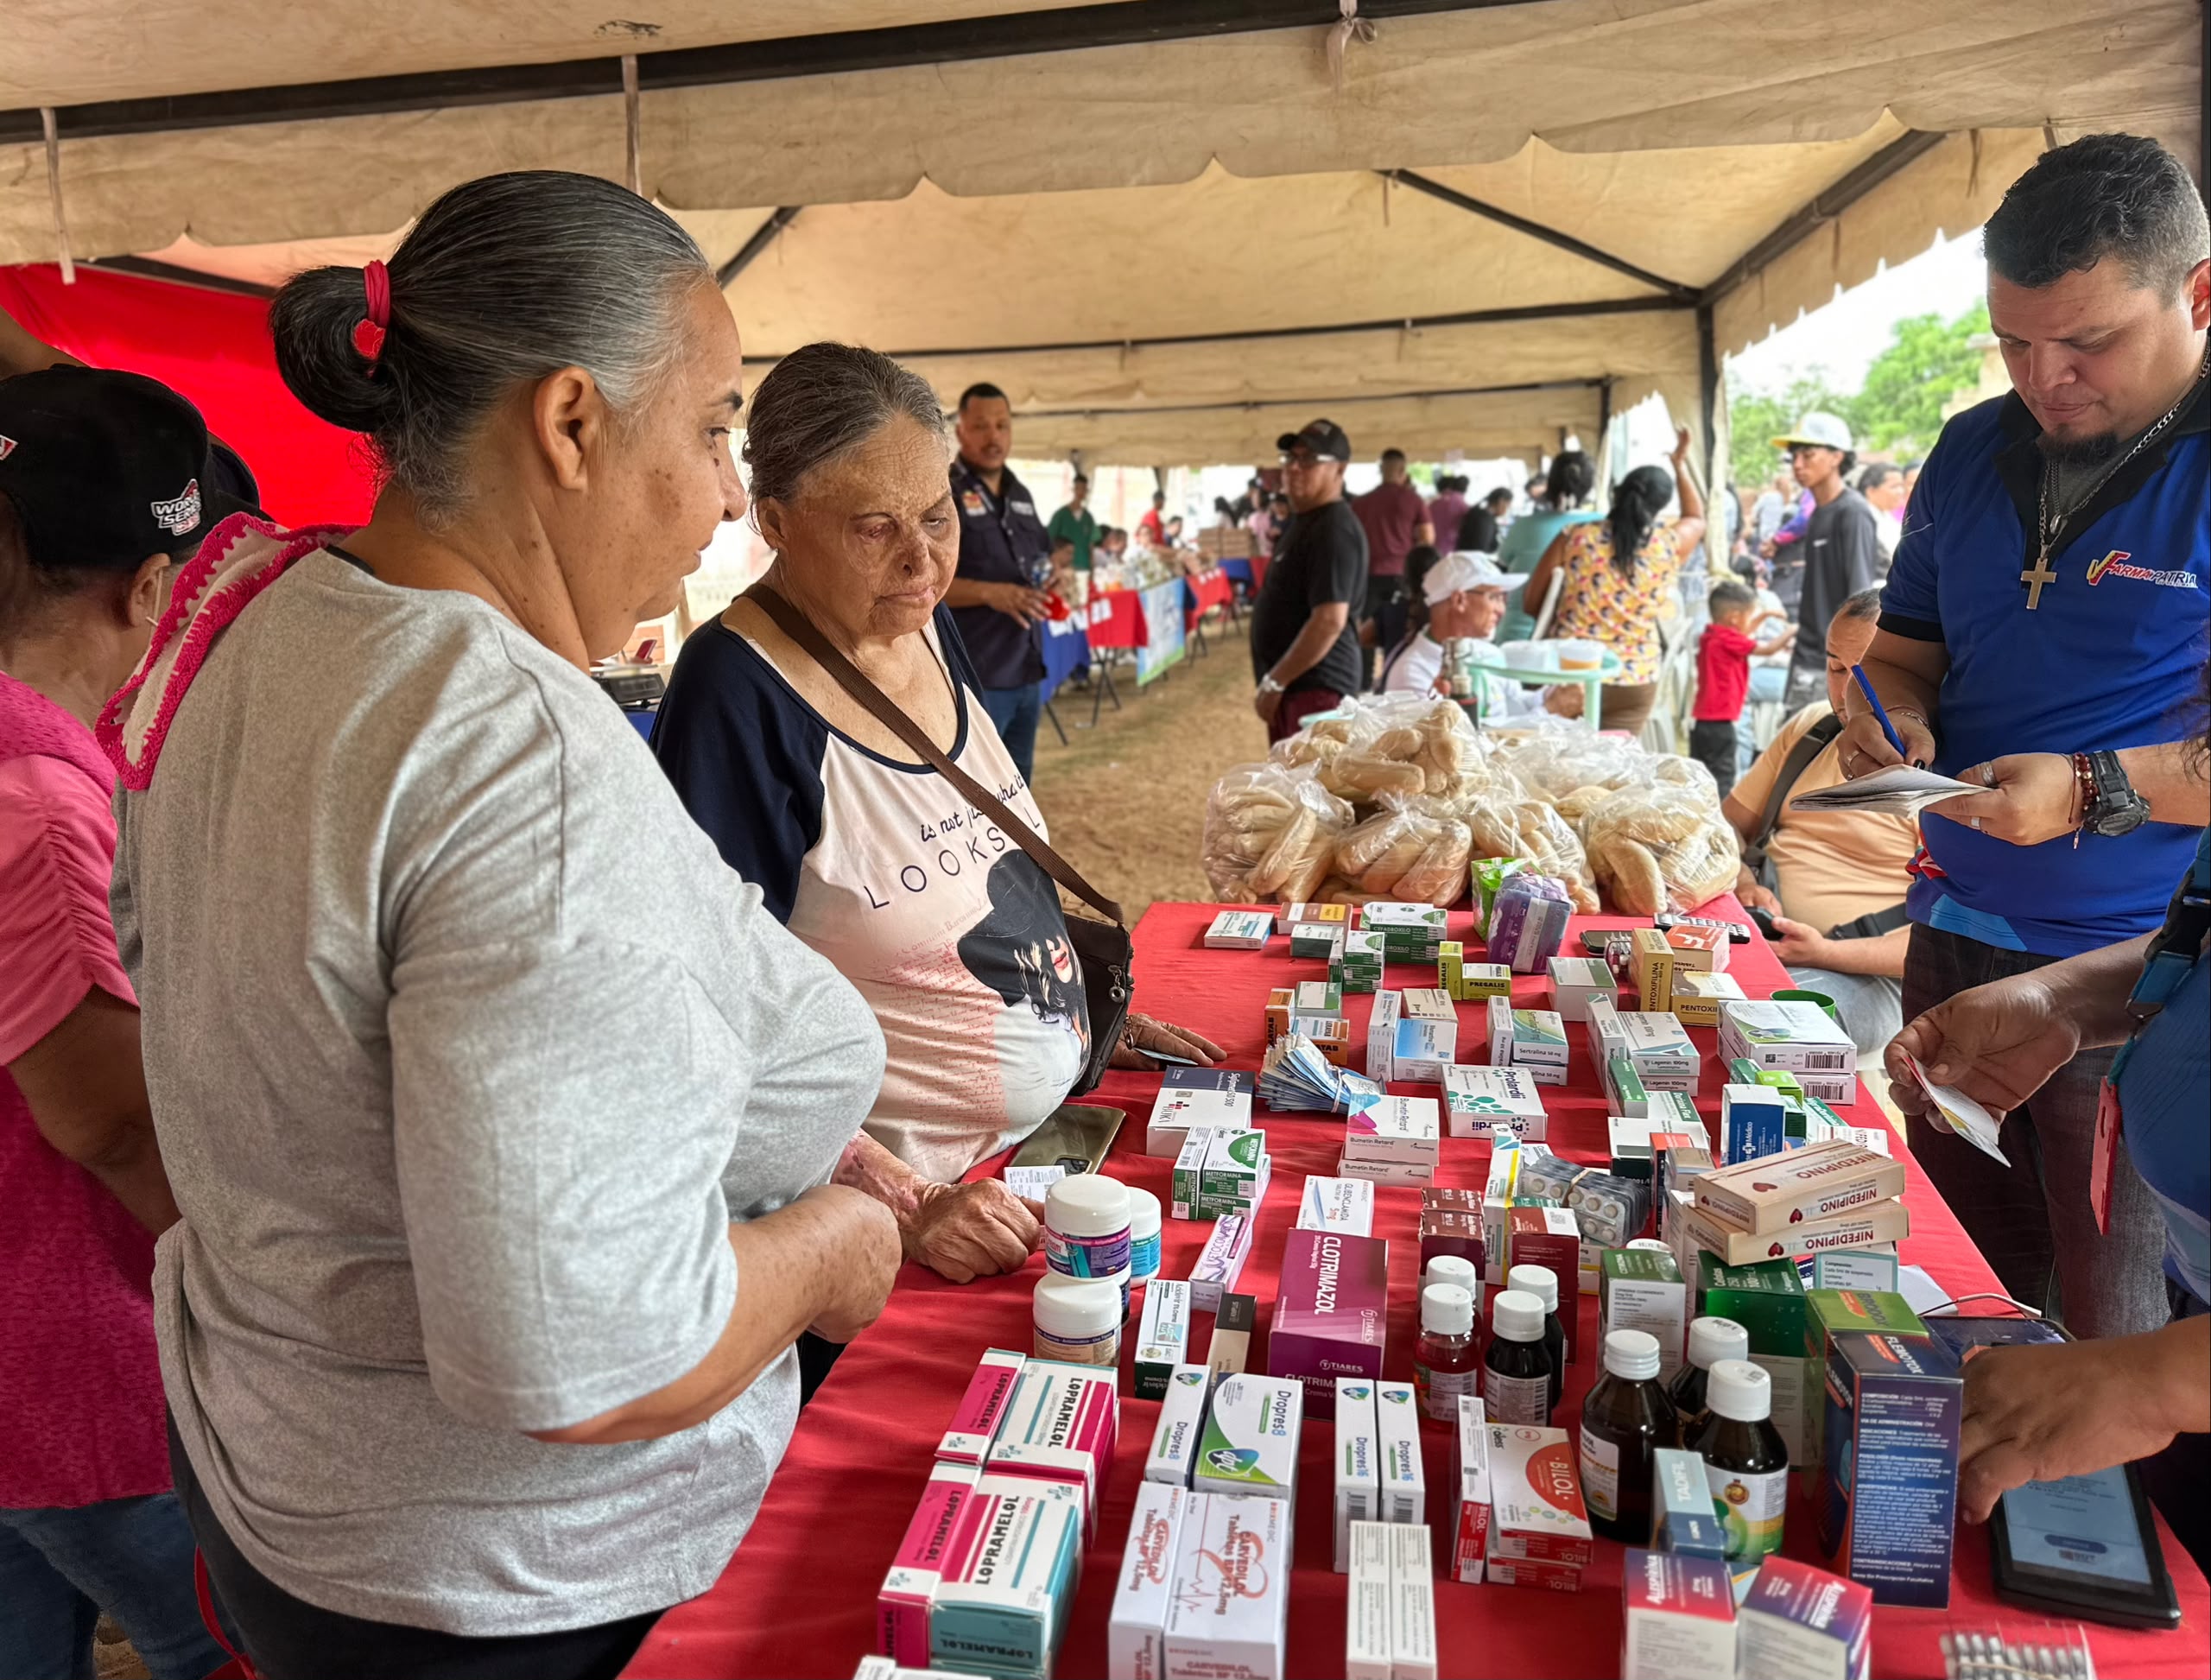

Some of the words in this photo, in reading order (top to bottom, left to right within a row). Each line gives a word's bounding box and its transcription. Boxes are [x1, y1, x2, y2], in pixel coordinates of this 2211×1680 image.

[940, 812, 963, 834] not
[966, 806, 985, 828] ju
[864, 826, 1006, 910] LOOKS
[1650, 962, 1659, 1012] ENTOXIFILINA
[1796, 1151, 1883, 1179] NIFEDIPINO
[1201, 1196, 1237, 1206] METFORMINA
[1821, 1188, 1877, 1213] NIFEDIPINO
[1806, 1230, 1873, 1249] NIFEDIPINO
[1315, 1236, 1342, 1315] CLOTRIMAZOL
[1364, 1318, 1376, 1342] TIARES
[1329, 1361, 1364, 1373] TIARES
[1884, 1335, 1925, 1374] FLEMOTOX
[1285, 1373, 1336, 1388] CLOTRIMA
[978, 1373, 1010, 1430] LOPRAMELOL
[1048, 1377, 1084, 1449] LOPRAMELOL
[1549, 1461, 1575, 1495] BILOL
[924, 1489, 962, 1563] LOPRAMELOL
[975, 1495, 1020, 1585] LOPRAMELOL
[1225, 1514, 1239, 1553] Tabletas
[1147, 1519, 1165, 1577] CARVEDILOL
[1236, 1530, 1251, 1597] CARVEDILOL
[1214, 1576, 1232, 1615] 12,5mg
[940, 1639, 1033, 1660] LOPRAMELOL
